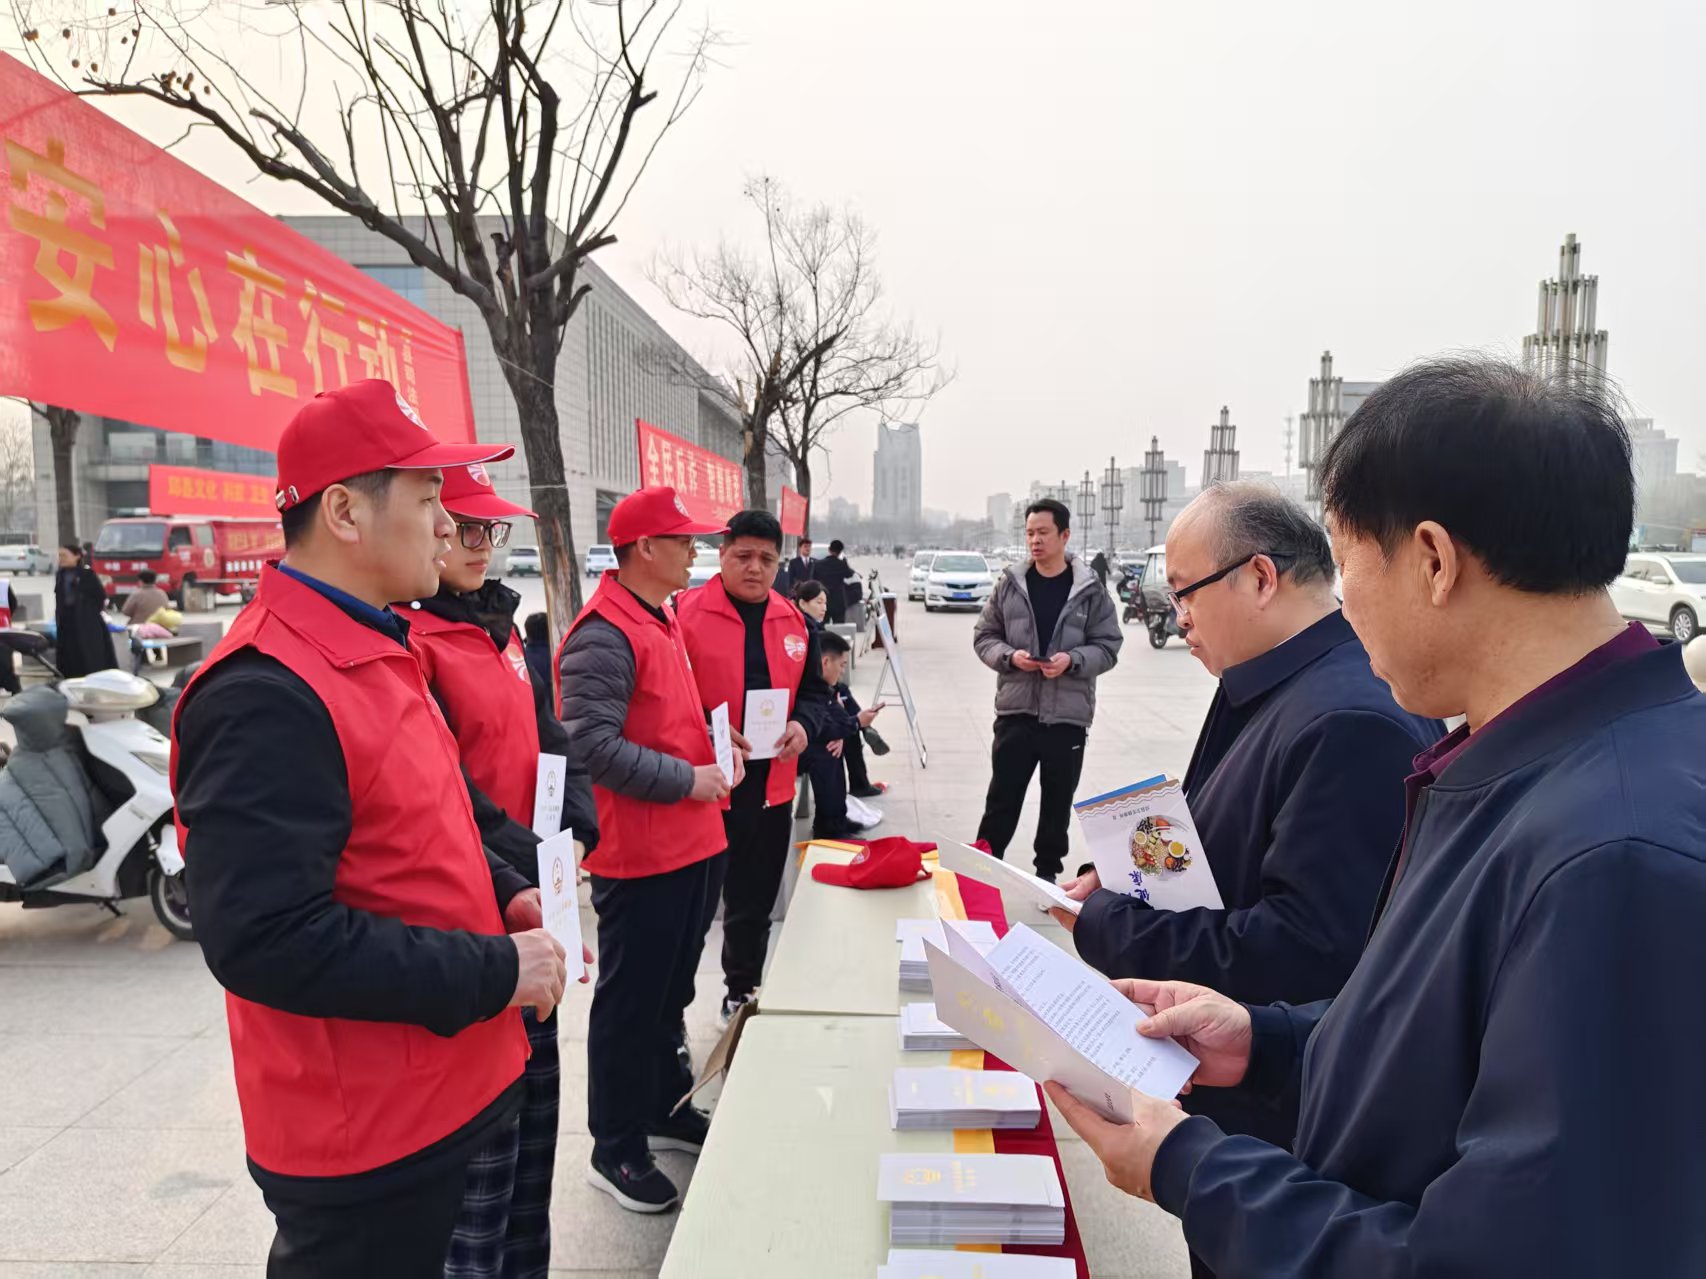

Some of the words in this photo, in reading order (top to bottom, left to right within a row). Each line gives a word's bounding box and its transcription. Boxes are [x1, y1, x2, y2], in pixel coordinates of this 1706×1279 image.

[5, 137, 400, 398] 安心在行动
